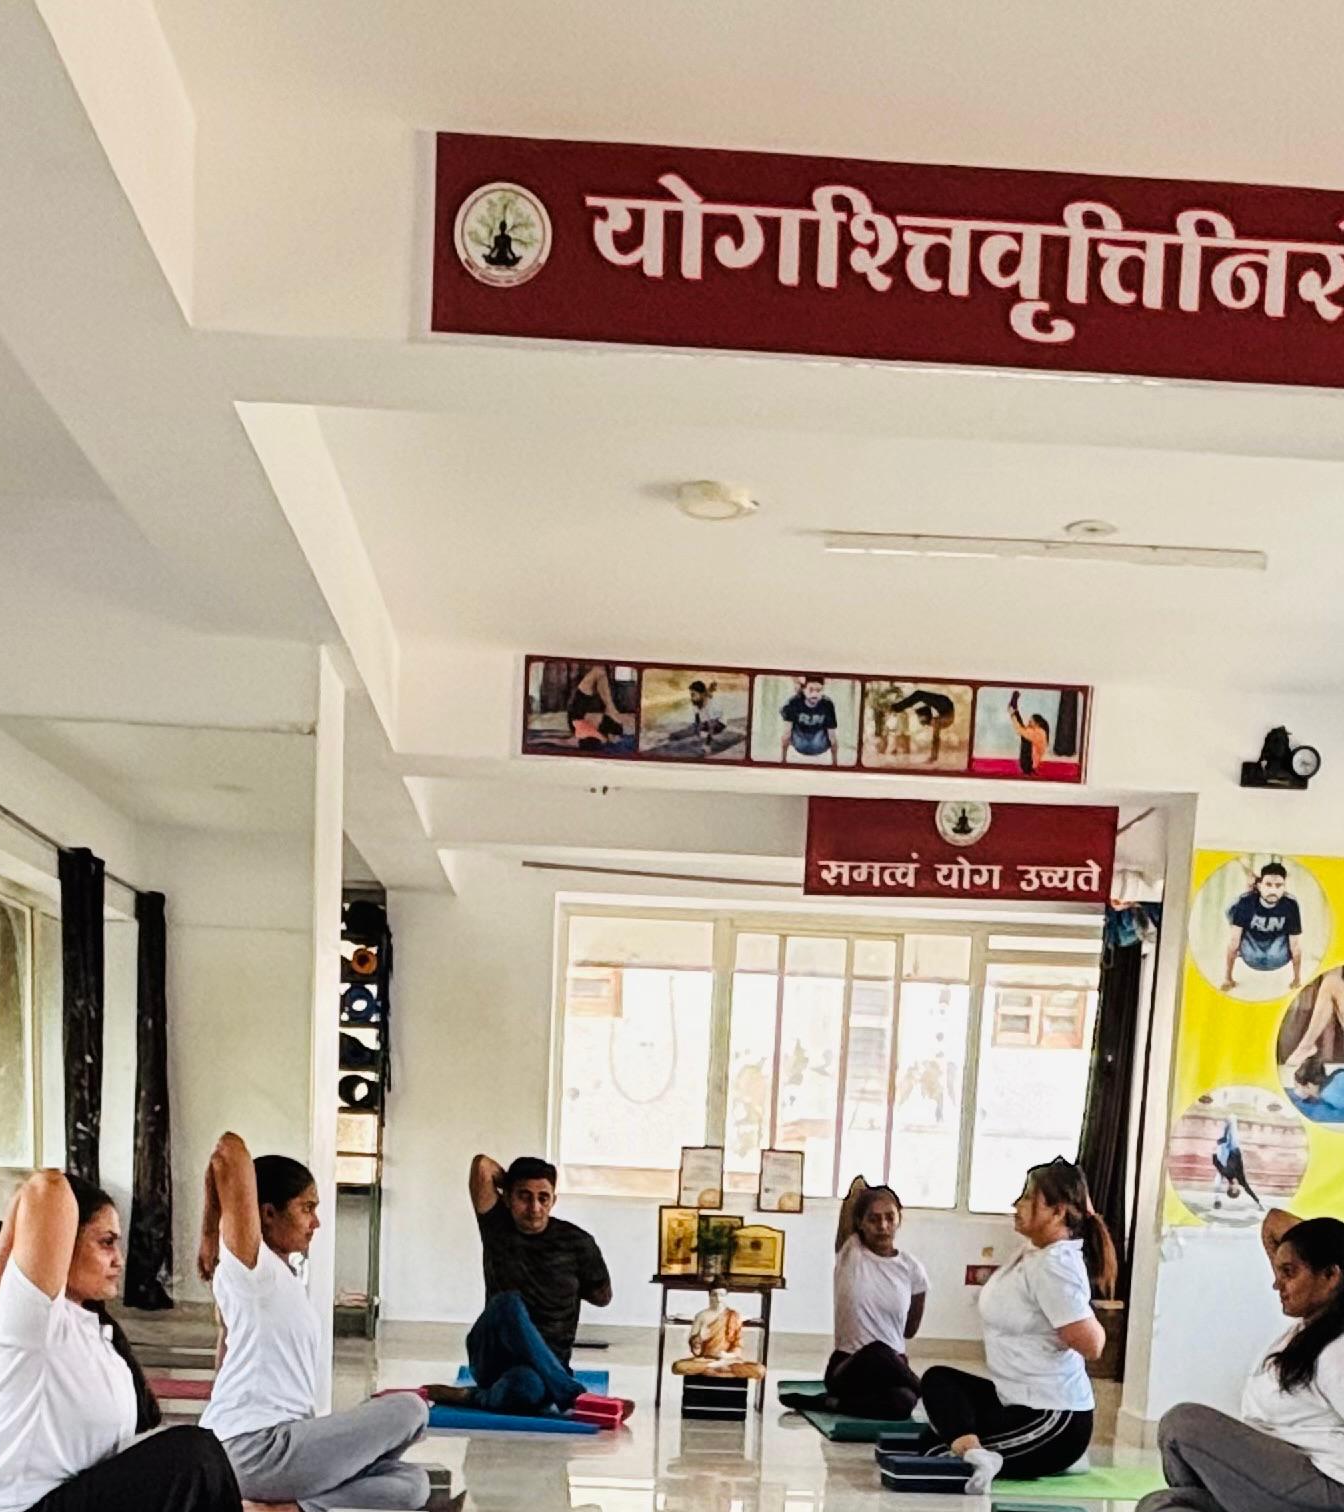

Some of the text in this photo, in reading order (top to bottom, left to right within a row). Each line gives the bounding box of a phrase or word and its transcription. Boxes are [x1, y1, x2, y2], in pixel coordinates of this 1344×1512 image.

[817, 852, 921, 888] समत्वं
[934, 856, 1003, 891] योग
[1250, 913, 1286, 932] RUN
